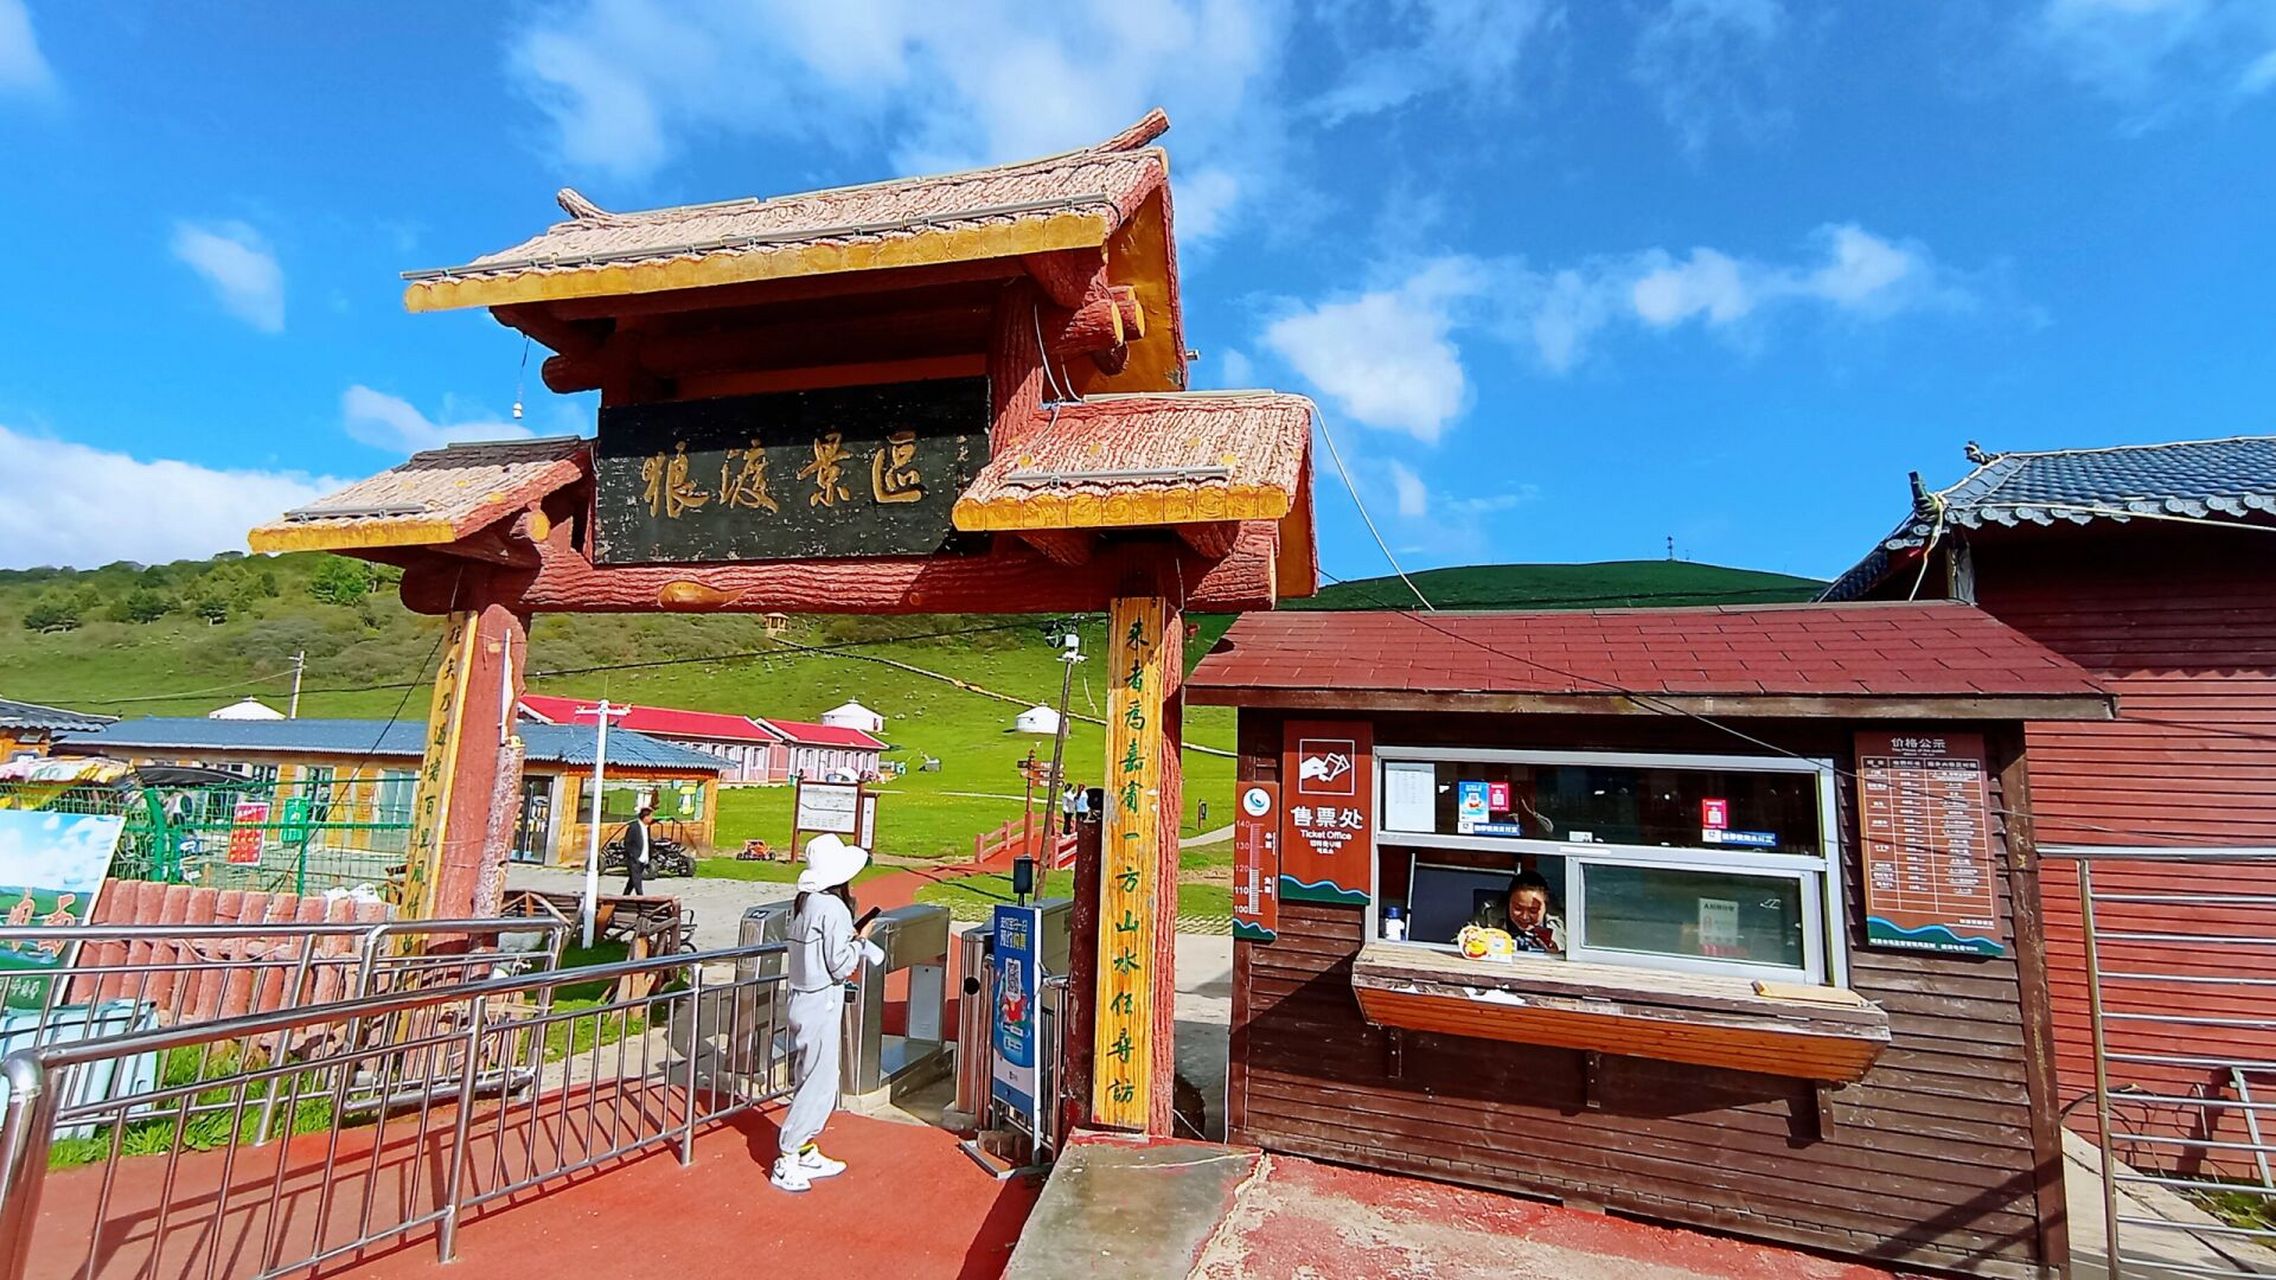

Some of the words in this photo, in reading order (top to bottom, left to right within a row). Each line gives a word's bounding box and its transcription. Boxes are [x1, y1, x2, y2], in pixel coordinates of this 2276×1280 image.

[1891, 738, 1946, 749] 价格公示
[1290, 806, 1364, 830] 售票处
[1236, 820, 1250, 828] 140
[1300, 829, 1326, 839] Ticket
[1327, 831, 1352, 840] Office
[1235, 841, 1250, 850] 130
[1235, 865, 1250, 873] 120
[1234, 887, 1249, 895] 110
[1234, 905, 1249, 914] 100
